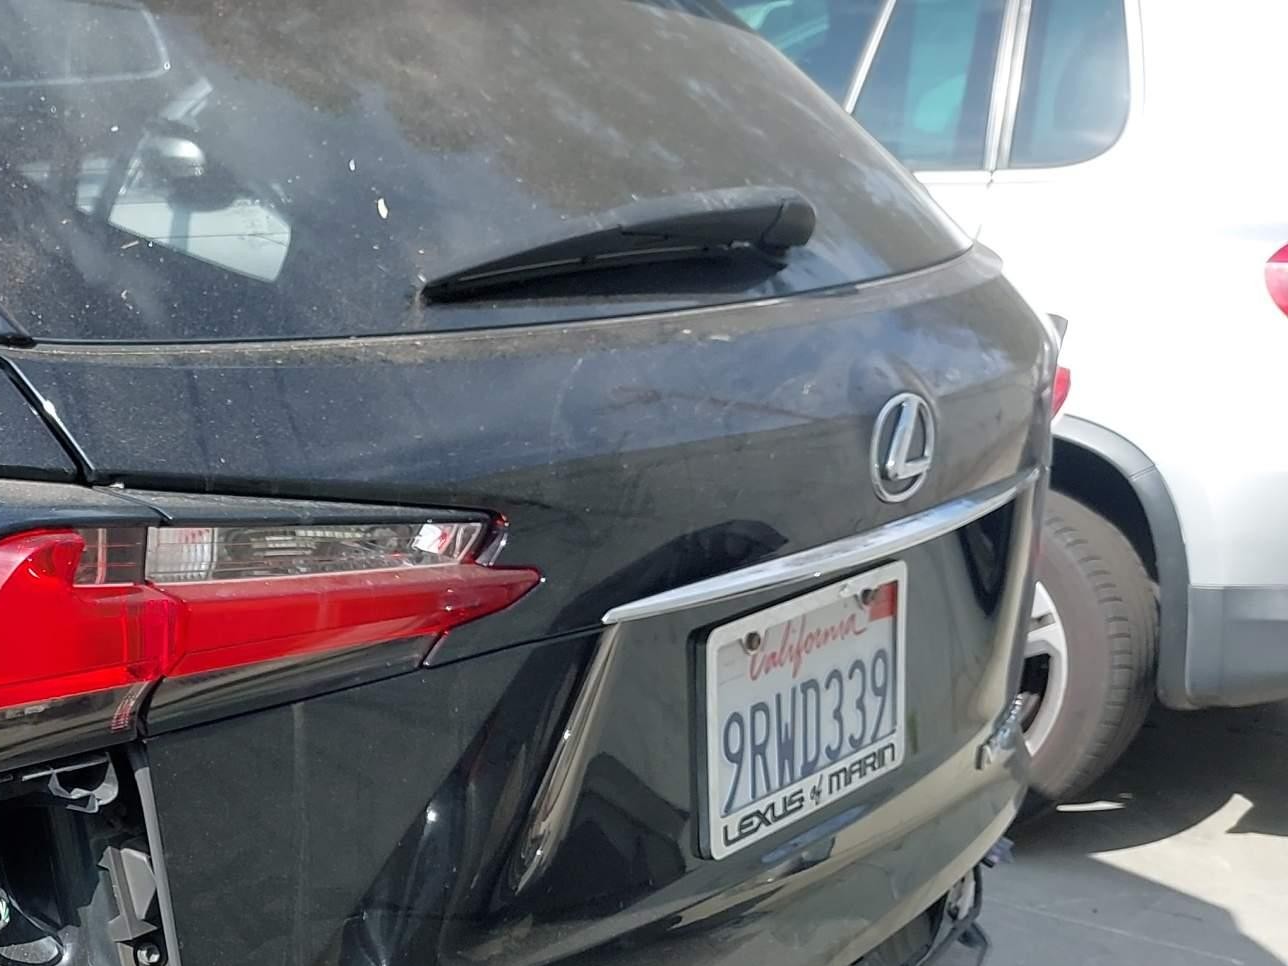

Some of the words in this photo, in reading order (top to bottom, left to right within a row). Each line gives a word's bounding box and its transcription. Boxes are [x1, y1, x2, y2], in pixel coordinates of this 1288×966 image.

[749, 612, 868, 681] California
[722, 647, 889, 815] 9RWD339
[723, 788, 805, 847] LEXUS
[810, 773, 823, 805] of
[828, 742, 895, 795] MARIN
